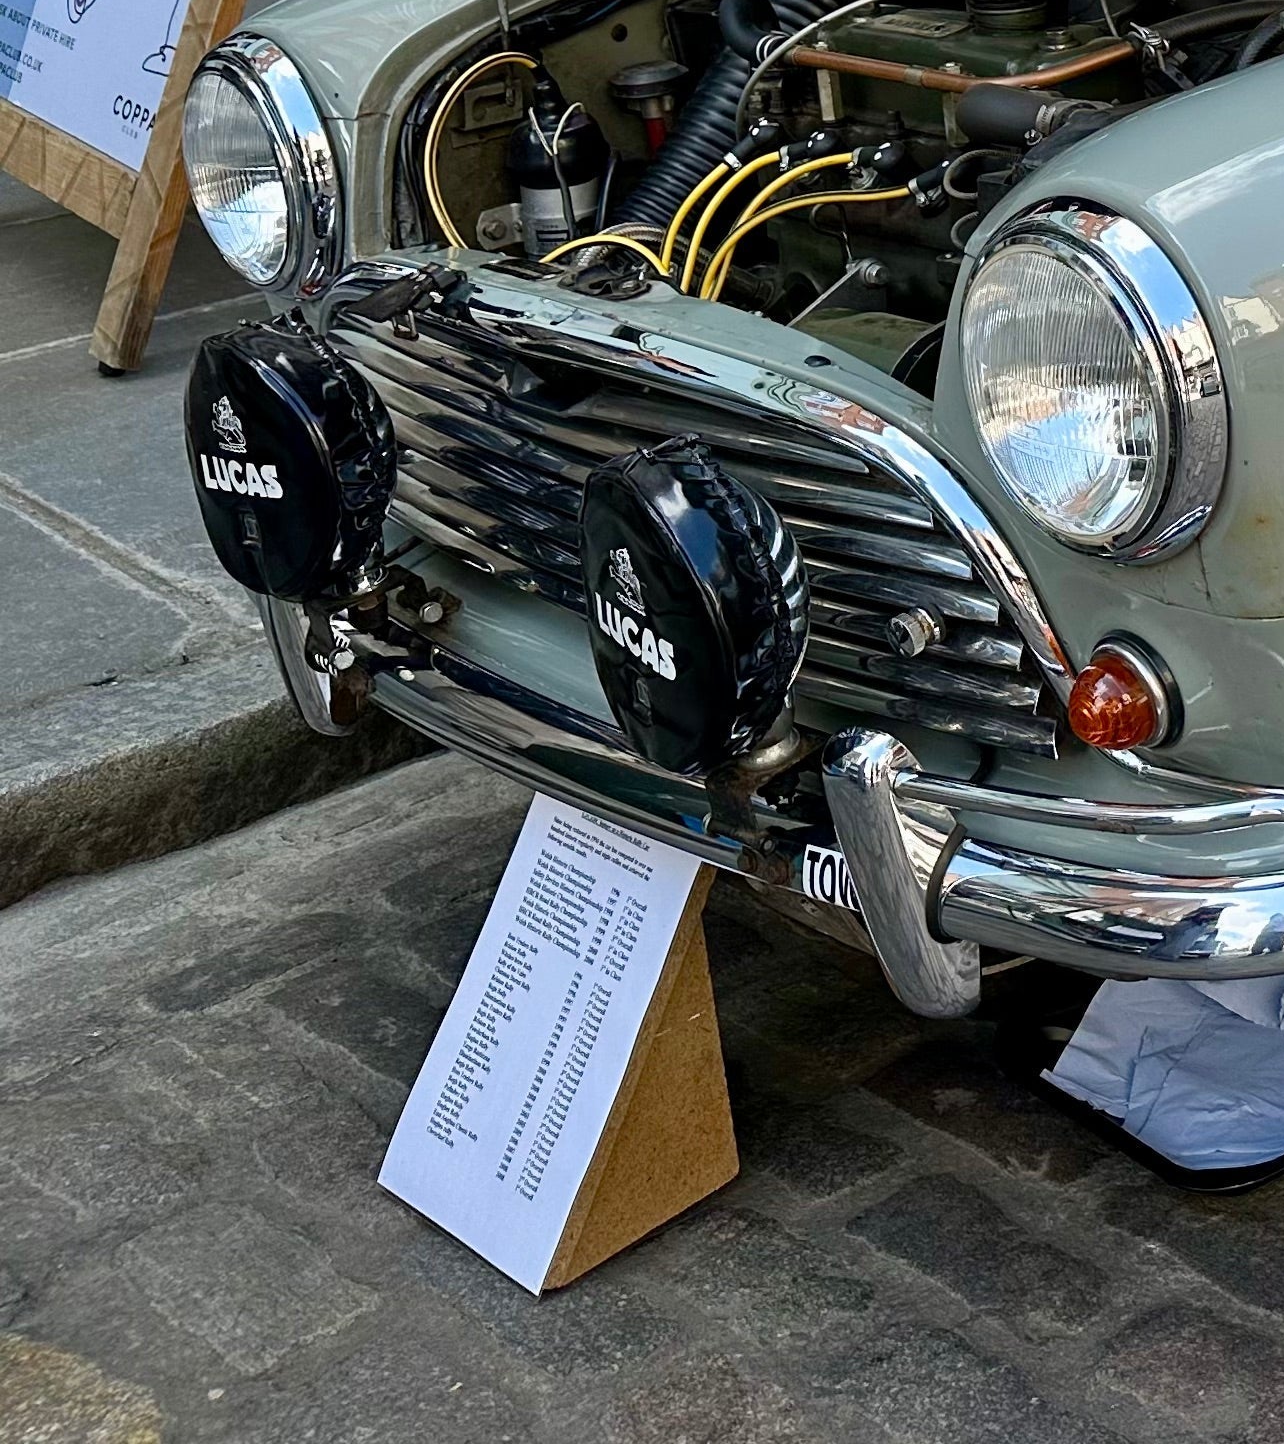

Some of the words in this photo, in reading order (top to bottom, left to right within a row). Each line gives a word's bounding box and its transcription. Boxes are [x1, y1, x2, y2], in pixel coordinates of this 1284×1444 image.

[8, 7, 31, 29] ABOUT
[31, 19, 59, 43] PRIVATE
[59, 29, 77, 51] HIRE
[112, 94, 157, 133] COPPA
[200, 453, 284, 499] LUCAS
[594, 591, 677, 681] LUCAS
